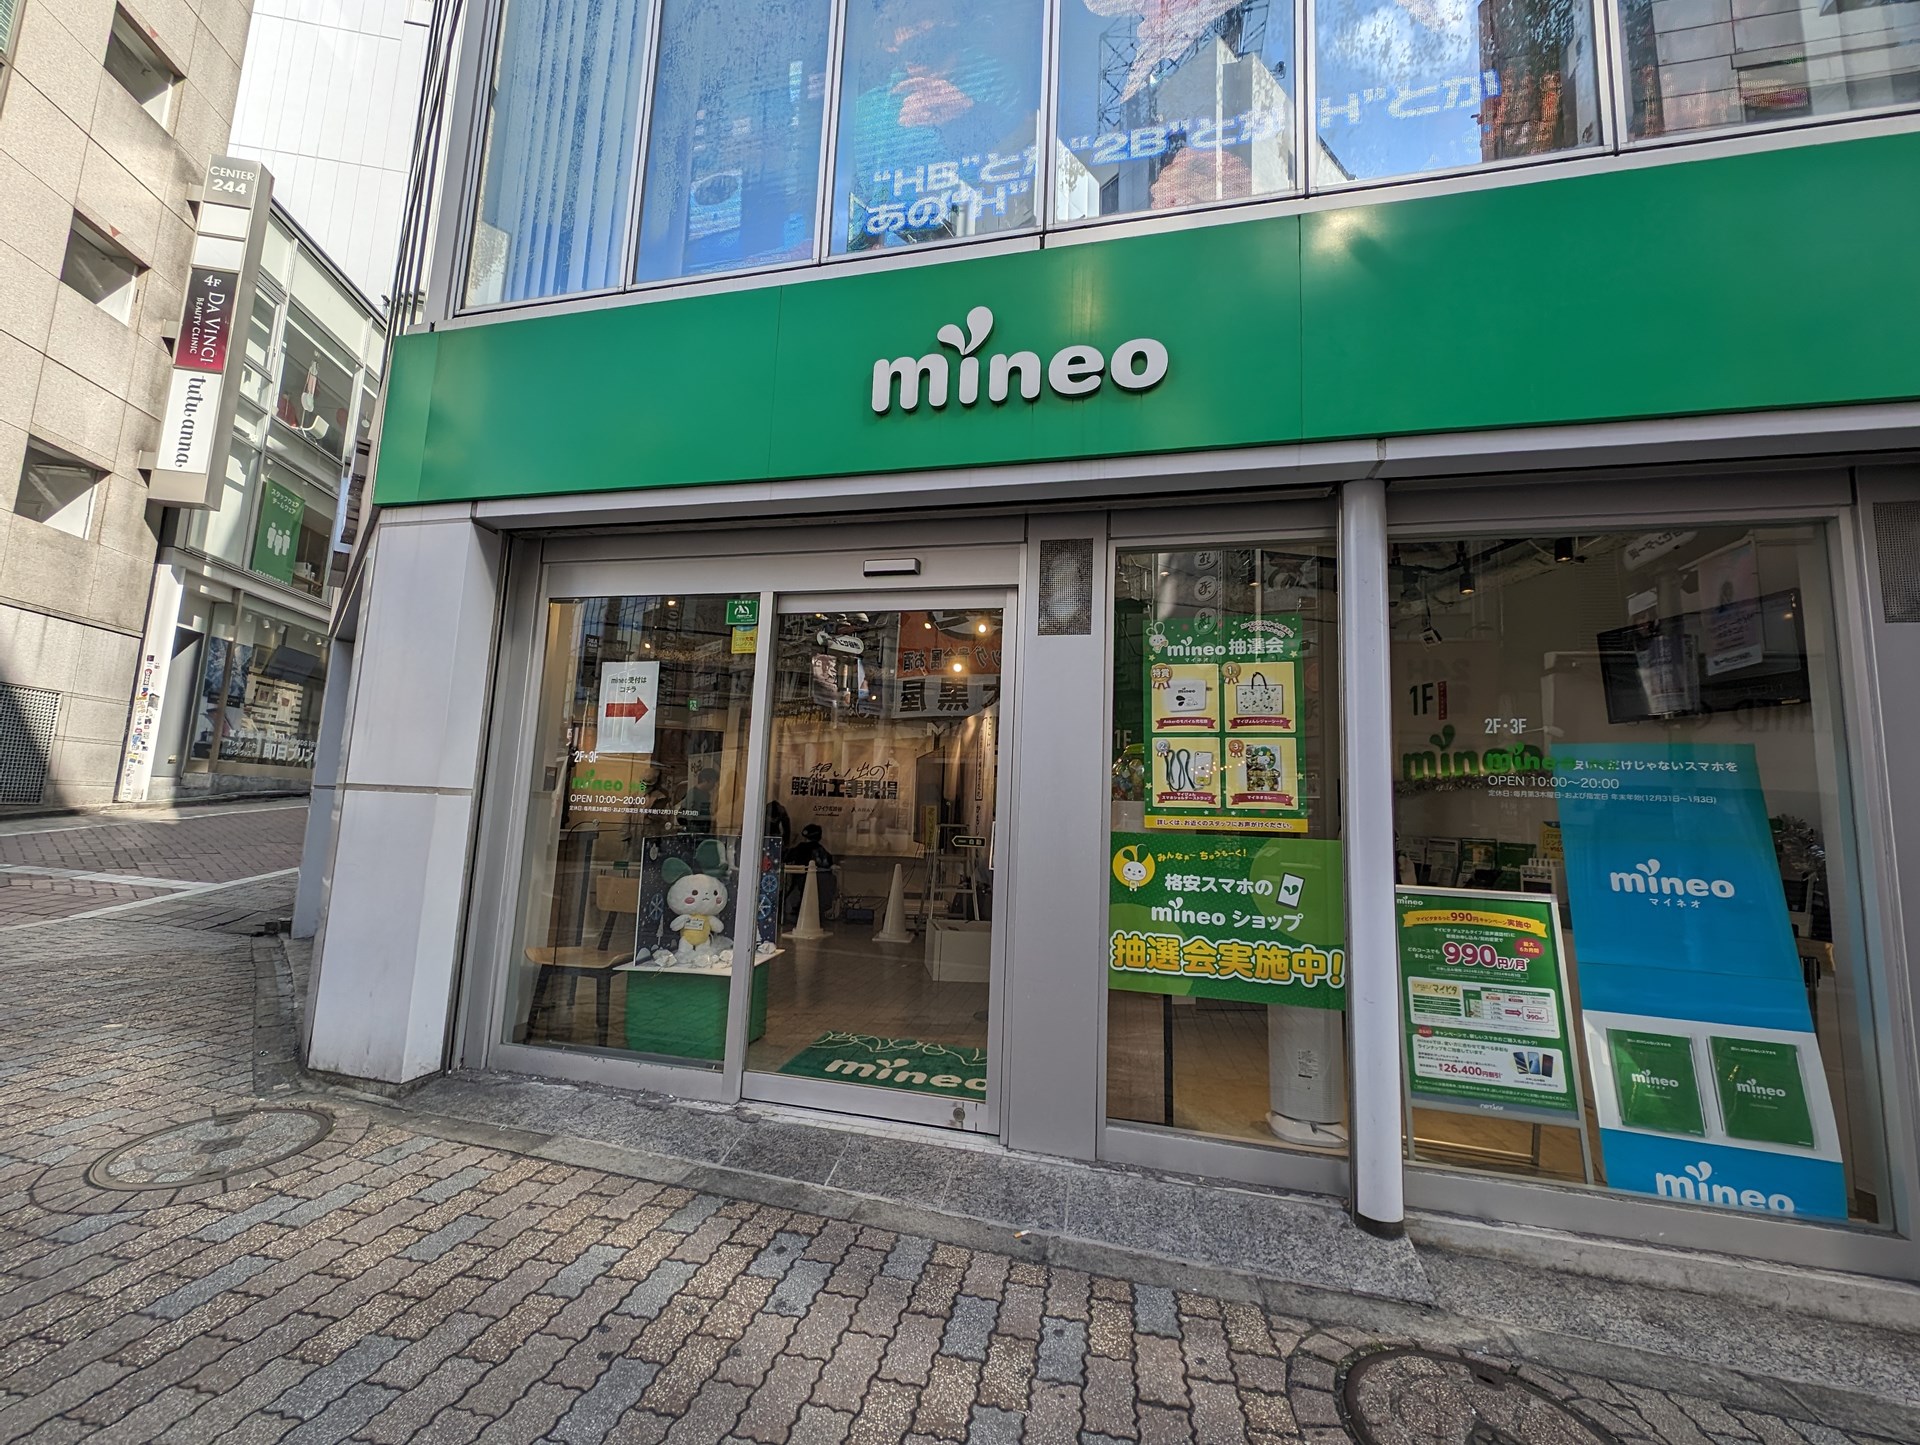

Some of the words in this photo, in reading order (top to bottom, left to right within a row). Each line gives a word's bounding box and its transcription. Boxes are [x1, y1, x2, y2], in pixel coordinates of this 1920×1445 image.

[209, 166, 255, 181] CENTER
[212, 178, 247, 195] 244
[204, 274, 221, 287] 4F
[193, 297, 205, 326] BEAUTY
[189, 327, 201, 354] CLINIC
[200, 318, 221, 363] VINCI
[872, 306, 1169, 412] mineo
[1167, 636, 1227, 657] mineo
[1228, 636, 1284, 656] 抽選会
[1152, 668, 1171, 679] 特賞
[1409, 682, 1434, 716] 1F
[1488, 775, 1525, 787] OPEN
[570, 794, 593, 803] OPEN
[1165, 873, 1274, 896] 格安スマホの
[1610, 859, 1736, 898] mineo
[1397, 895, 1424, 906] mineo
[1649, 898, 1701, 909] マイネオ
[1151, 897, 1226, 926] mineo
[1232, 910, 1304, 932] ショップ
[1110, 930, 1346, 989] 抽選会実施中!
[1432, 983, 1458, 995] マイピタ
[1631, 1069, 1680, 1088] mineo
[1736, 1078, 1787, 1097] mineo
[1655, 1161, 1796, 1212] mineo
